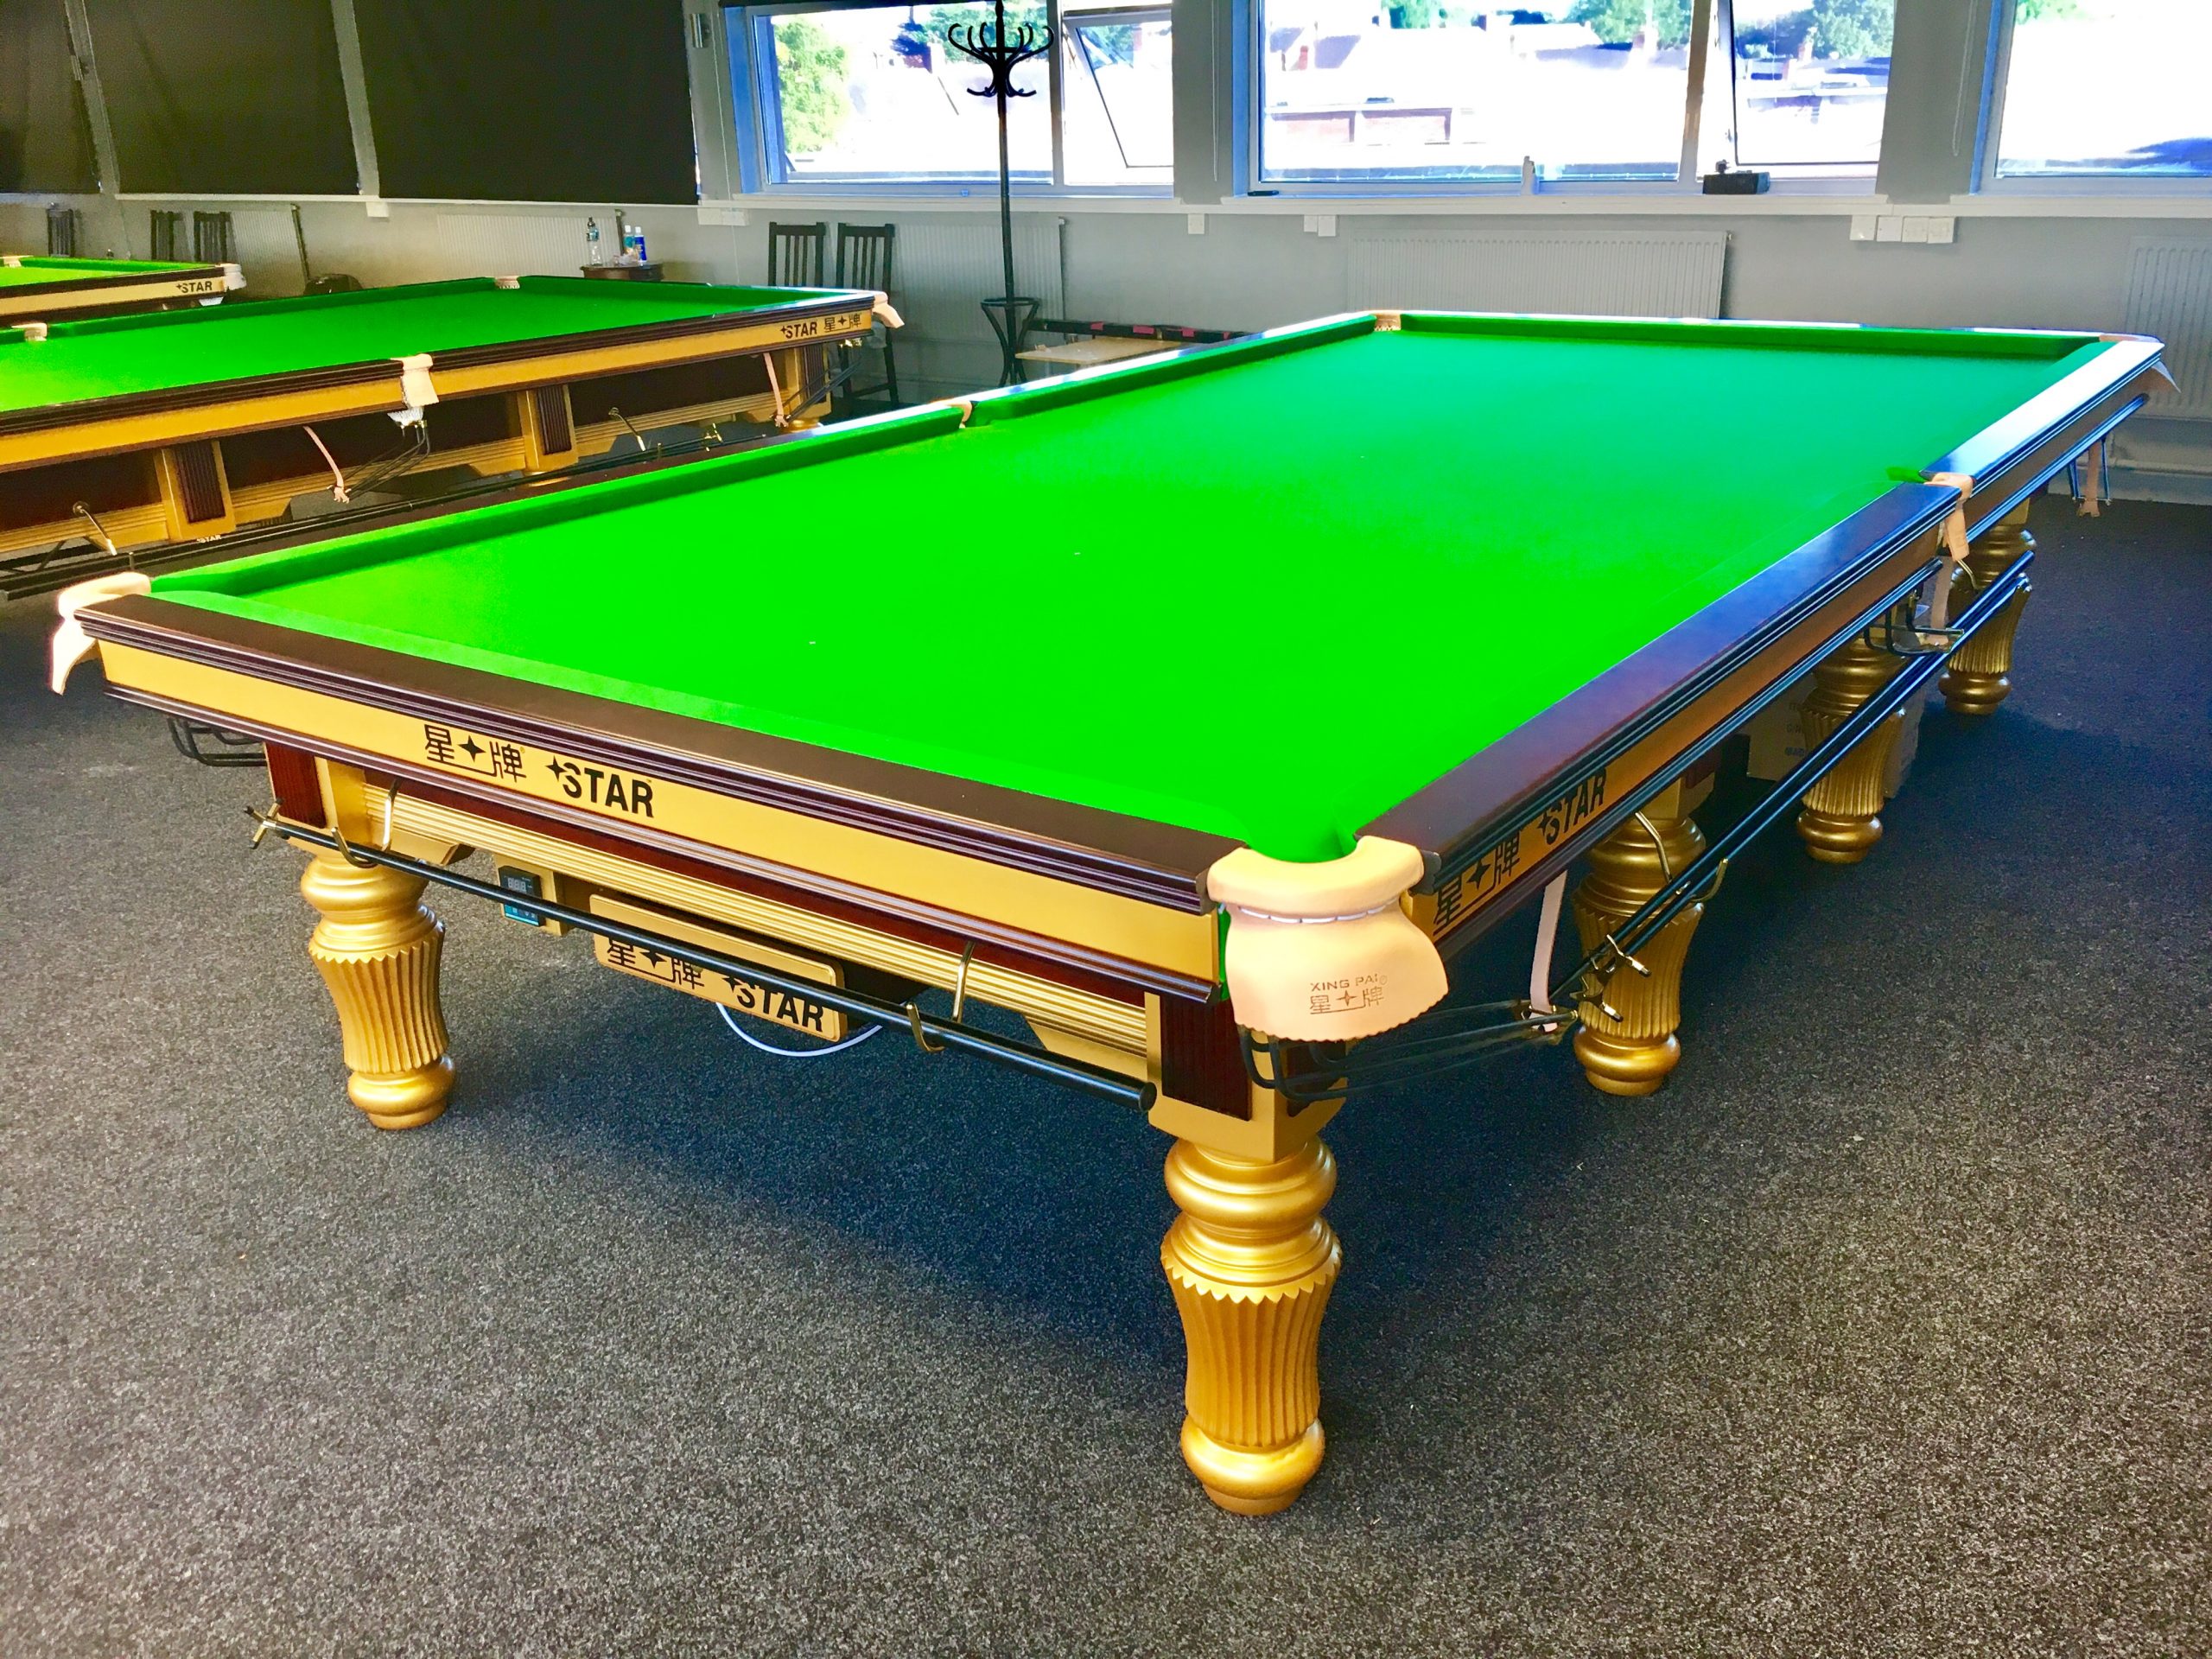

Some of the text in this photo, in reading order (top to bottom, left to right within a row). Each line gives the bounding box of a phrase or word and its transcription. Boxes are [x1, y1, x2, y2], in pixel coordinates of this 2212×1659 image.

[181, 281, 213, 294] STAR
[785, 321, 817, 339] STAR
[563, 762, 654, 818] STAR
[1545, 766, 1607, 846] STAR
[1310, 978, 1350, 992] XING
[736, 985, 824, 1033] STAR
